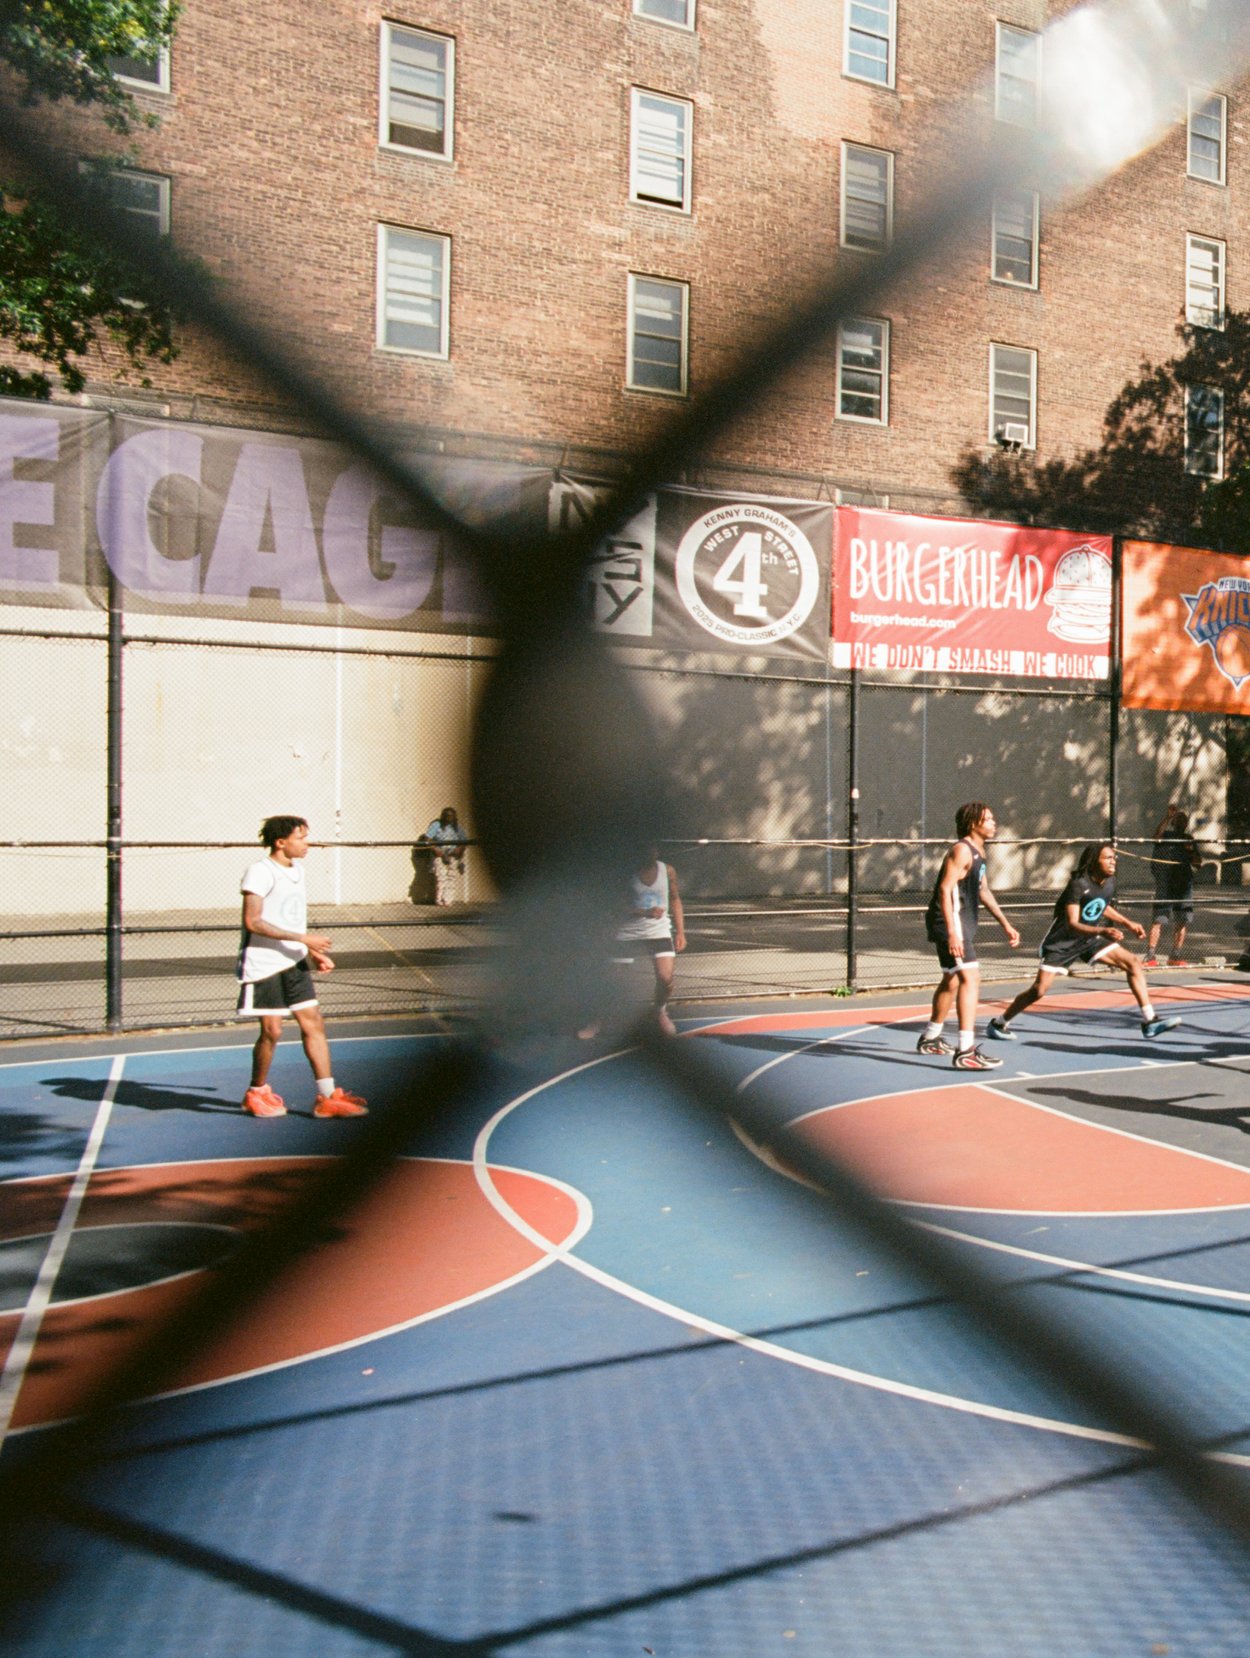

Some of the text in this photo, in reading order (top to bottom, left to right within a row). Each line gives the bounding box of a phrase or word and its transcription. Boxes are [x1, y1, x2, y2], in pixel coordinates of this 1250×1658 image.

[704, 508, 797, 538] KENNY GRAHAM'S
[704, 525, 740, 552] WEST
[764, 530, 800, 576] STREET
[713, 531, 778, 618] 4 th
[850, 540, 1044, 612] BURGERHEAD
[1219, 579, 1236, 589] NEW
[850, 611, 957, 629] burgerhead.com
[853, 643, 877, 668] WE
[887, 645, 941, 670] DON'T
[1023, 651, 1047, 675] WE
[1055, 654, 1096, 677] COOK
